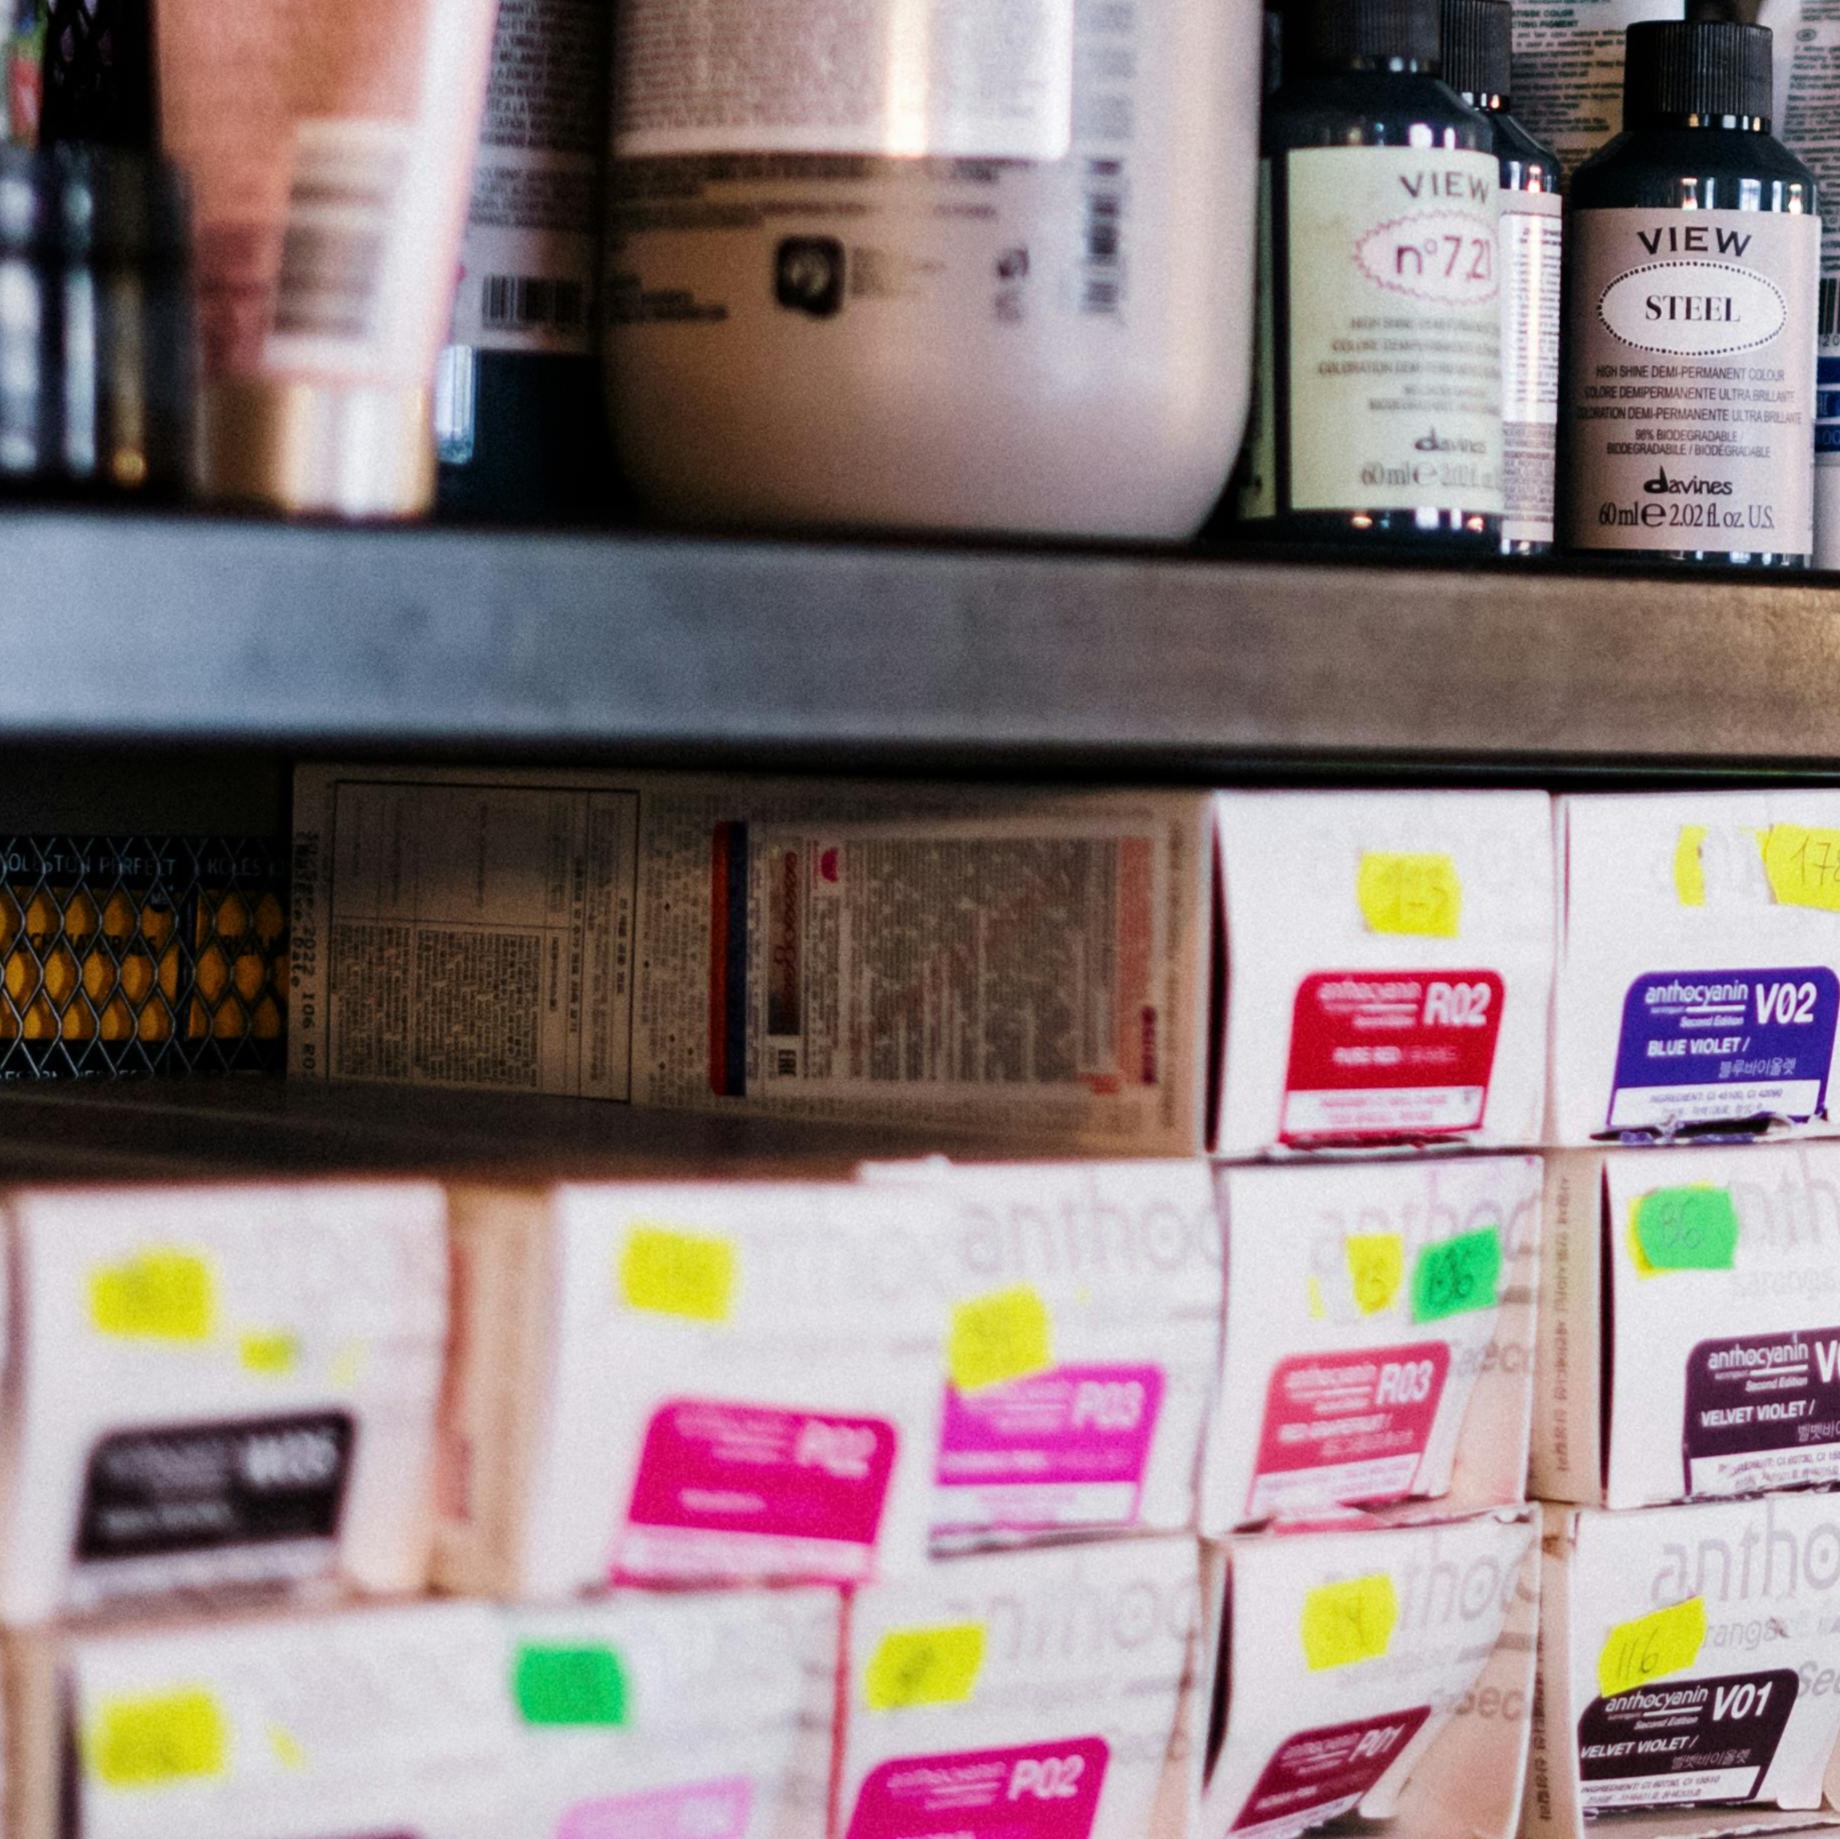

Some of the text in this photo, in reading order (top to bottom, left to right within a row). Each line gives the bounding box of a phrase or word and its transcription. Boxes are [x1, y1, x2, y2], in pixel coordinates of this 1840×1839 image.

[1400, 170, 1490, 205] VIEW
[1637, 226, 1752, 257] VIEW
[1645, 295, 1741, 322] STEEL
[1596, 365, 1784, 382] HIGH SHINE DEMI-PERMANENT COLOUR
[1619, 386, 1716, 400] DEMIPERMANENTE
[1719, 387, 1750, 401] ULTRA
[1627, 407, 1729, 422] DEMI-PERMANENTE
[1732, 409, 1763, 423] ULTRA
[1607, 442, 1686, 455] BIODEGRADABILE
[1657, 429, 1737, 442] BIODEGRADABLE
[1643, 465, 1733, 496] davines
[1669, 504, 1704, 527] 2.02
[1422, 980, 1490, 1026] R02
[1644, 979, 1818, 1025] anthocyanin V02
[1647, 1039, 1687, 1057] BLUE
[1690, 1037, 1741, 1055] VIOLET
[1708, 1342, 1809, 1369] anthocyanin
[1376, 1359, 1435, 1406] R03
[1745, 1376, 1808, 1392] Second Edition
[1701, 1406, 1754, 1428] VELVET
[1757, 1400, 1806, 1421] VIOLET
[1605, 1681, 1773, 1721] anthocyanin V01
[1634, 1716, 1698, 1731] Second Edition
[1581, 1742, 1635, 1759] VELVET
[1638, 1737, 1689, 1753] VIOLET
[1007, 1755, 1086, 1800] P02
